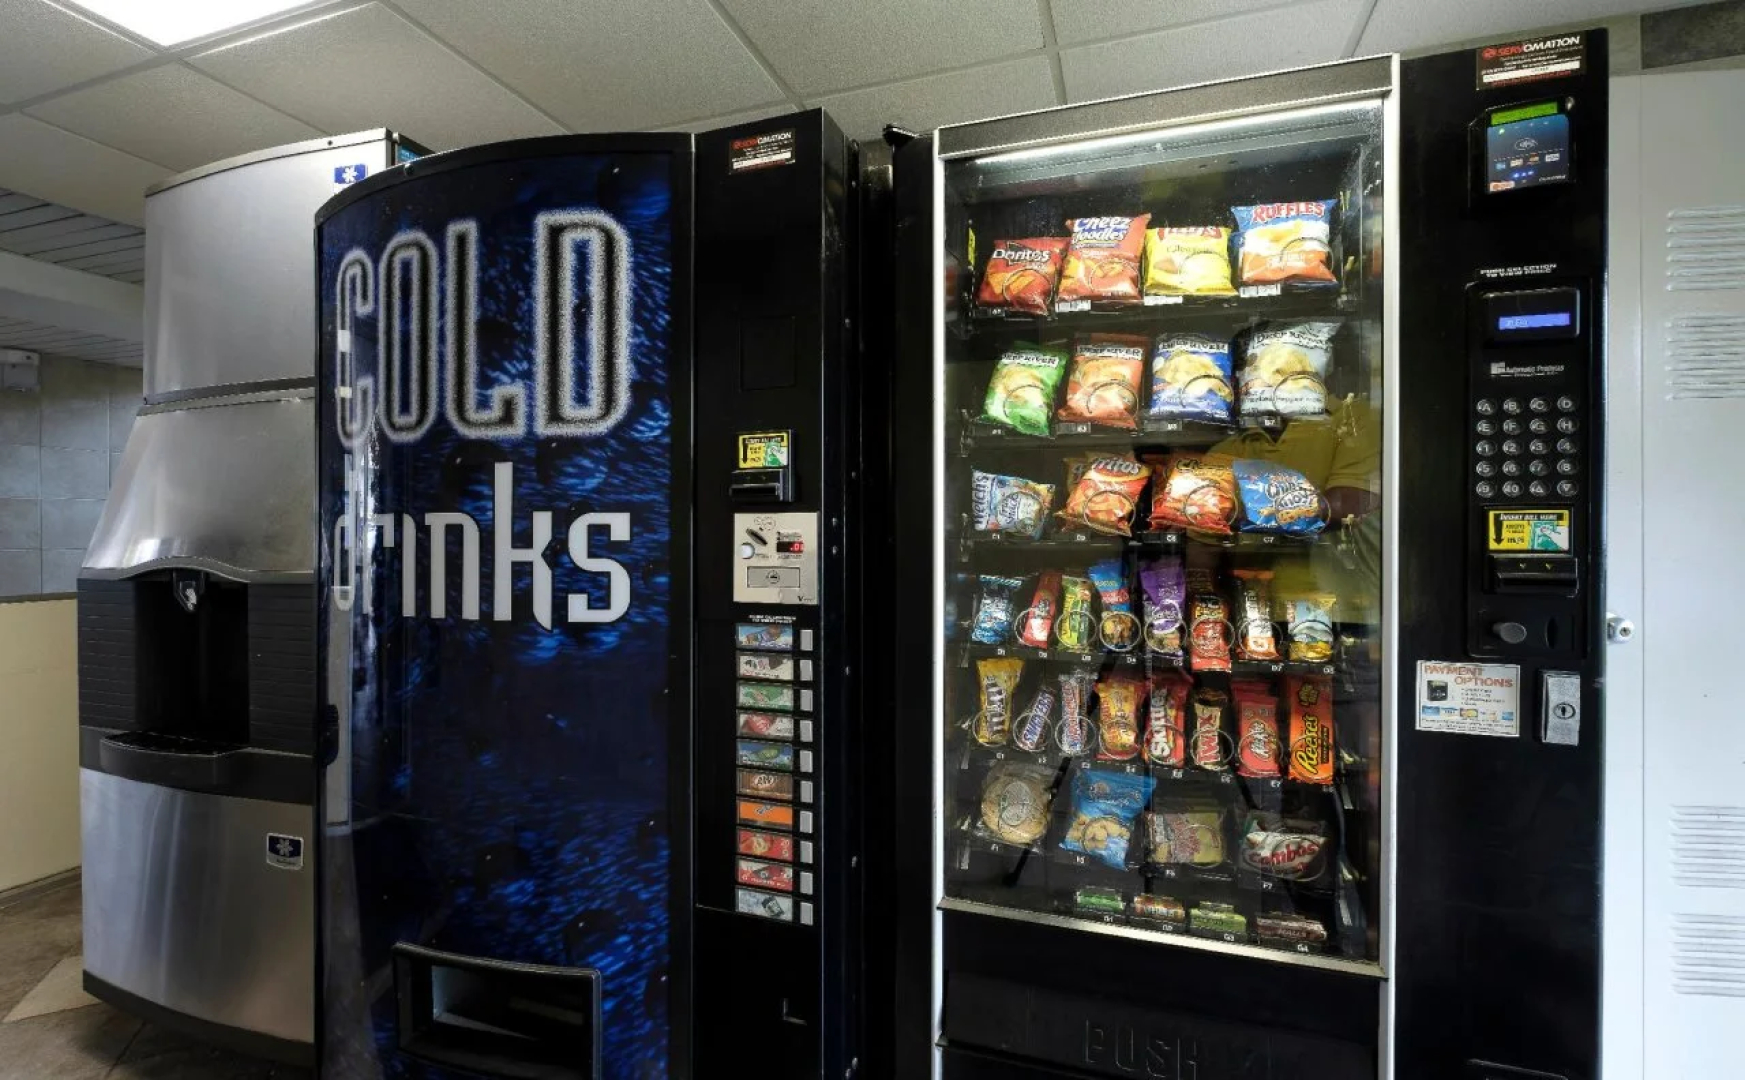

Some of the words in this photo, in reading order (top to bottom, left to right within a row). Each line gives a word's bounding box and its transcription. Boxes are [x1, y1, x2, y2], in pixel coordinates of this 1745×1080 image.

[1252, 201, 1325, 223] RUFFLES
[992, 249, 1051, 262] Doritos
[336, 207, 634, 449] COLD
[331, 453, 632, 632] drinks
[1425, 665, 1483, 677] PAYMENT
[1455, 676, 1513, 688] OPTIONS
[1085, 1018, 1199, 1080] PUSH
